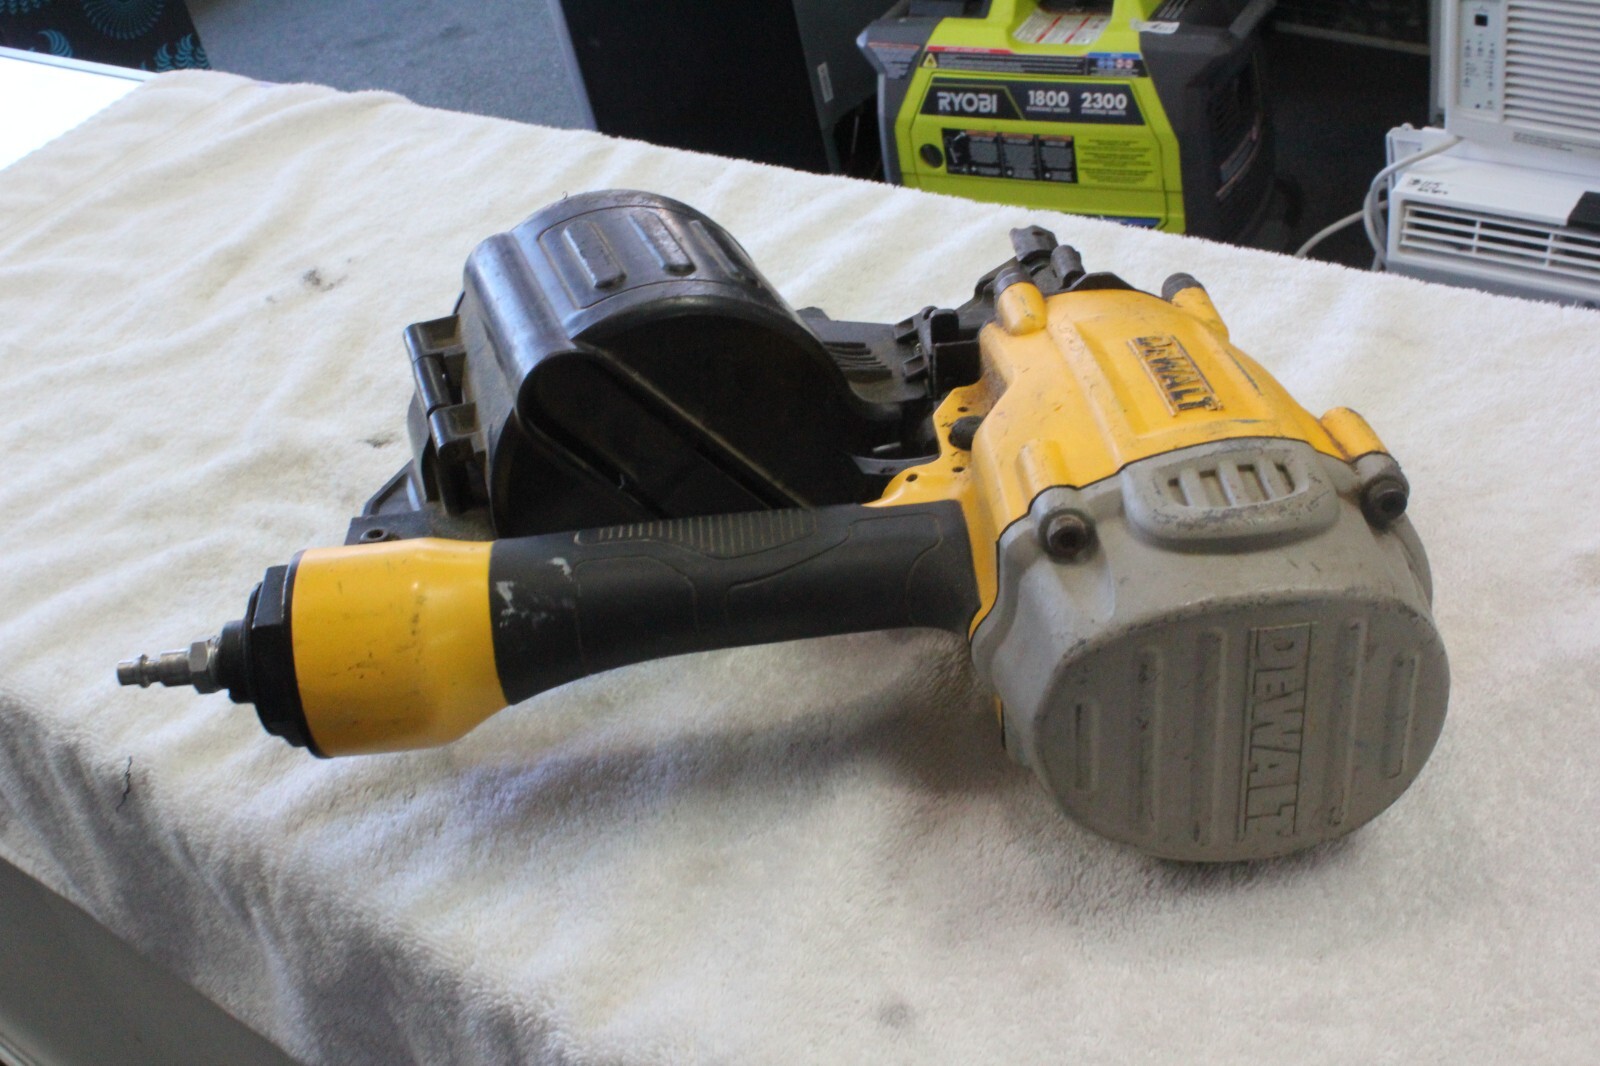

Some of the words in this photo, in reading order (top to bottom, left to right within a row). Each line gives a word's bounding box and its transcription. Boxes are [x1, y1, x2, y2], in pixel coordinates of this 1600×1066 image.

[936, 91, 998, 114] RYOBI
[1027, 90, 1070, 107] 1800
[1080, 92, 1128, 110] 2300
[1134, 335, 1221, 412] DEWALT
[1243, 622, 1311, 837] DEWALT
